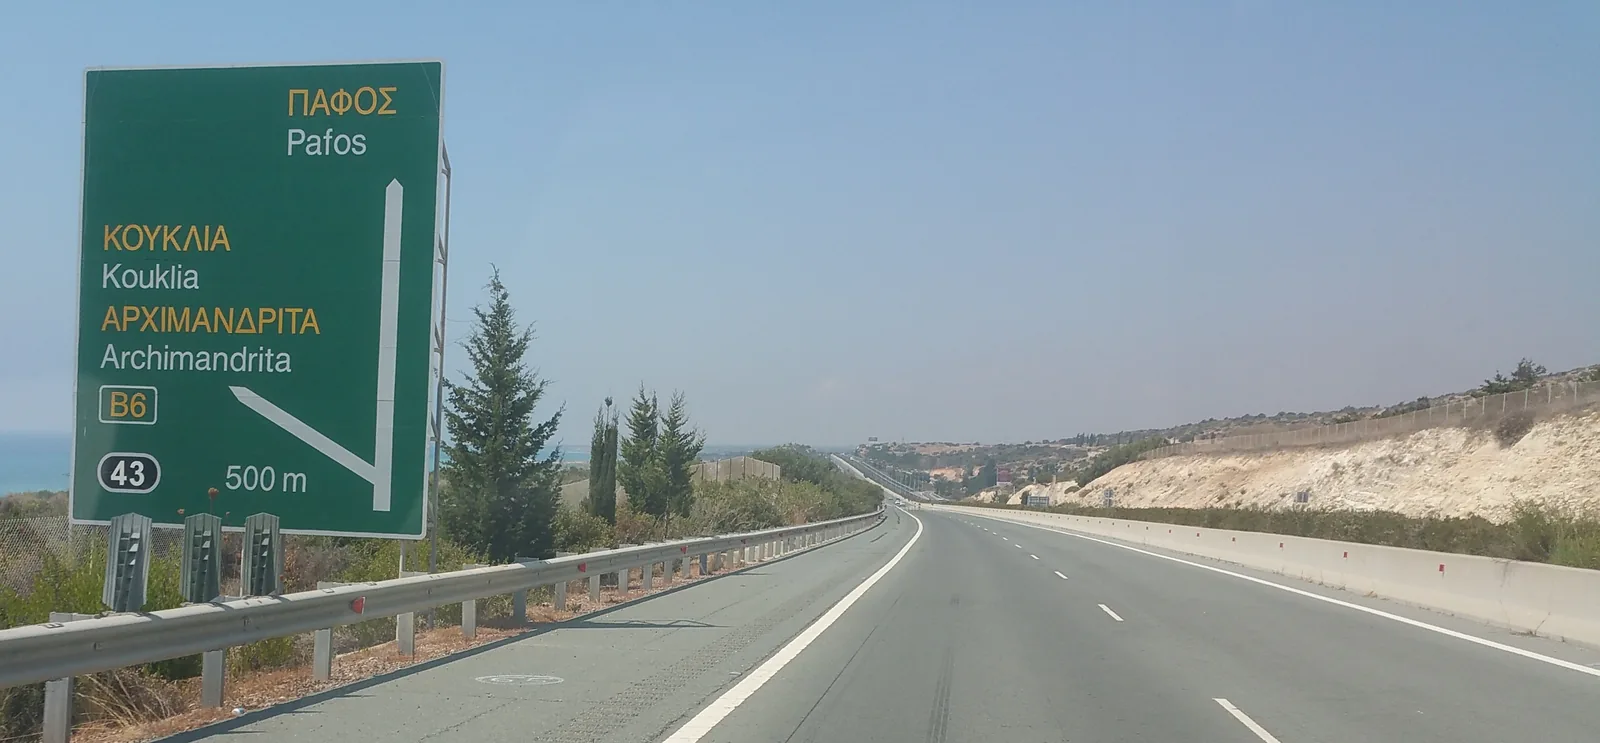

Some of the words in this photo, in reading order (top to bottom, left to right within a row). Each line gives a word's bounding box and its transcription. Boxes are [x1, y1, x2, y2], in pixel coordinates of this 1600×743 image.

[288, 86, 397, 116] ΠΑΦΟΣ
[287, 128, 367, 156] Pafos
[103, 224, 231, 252] ΚΟΥΚΛΙΑ
[102, 264, 200, 290] Kouklia
[101, 305, 321, 335] ΑΡΧΙΜΑΝΔΡΙΤΑ
[101, 344, 292, 373] Archimandrita
[110, 391, 147, 418] B6
[110, 460, 145, 487] 43
[225, 465, 276, 492] 500
[282, 472, 307, 493] m
